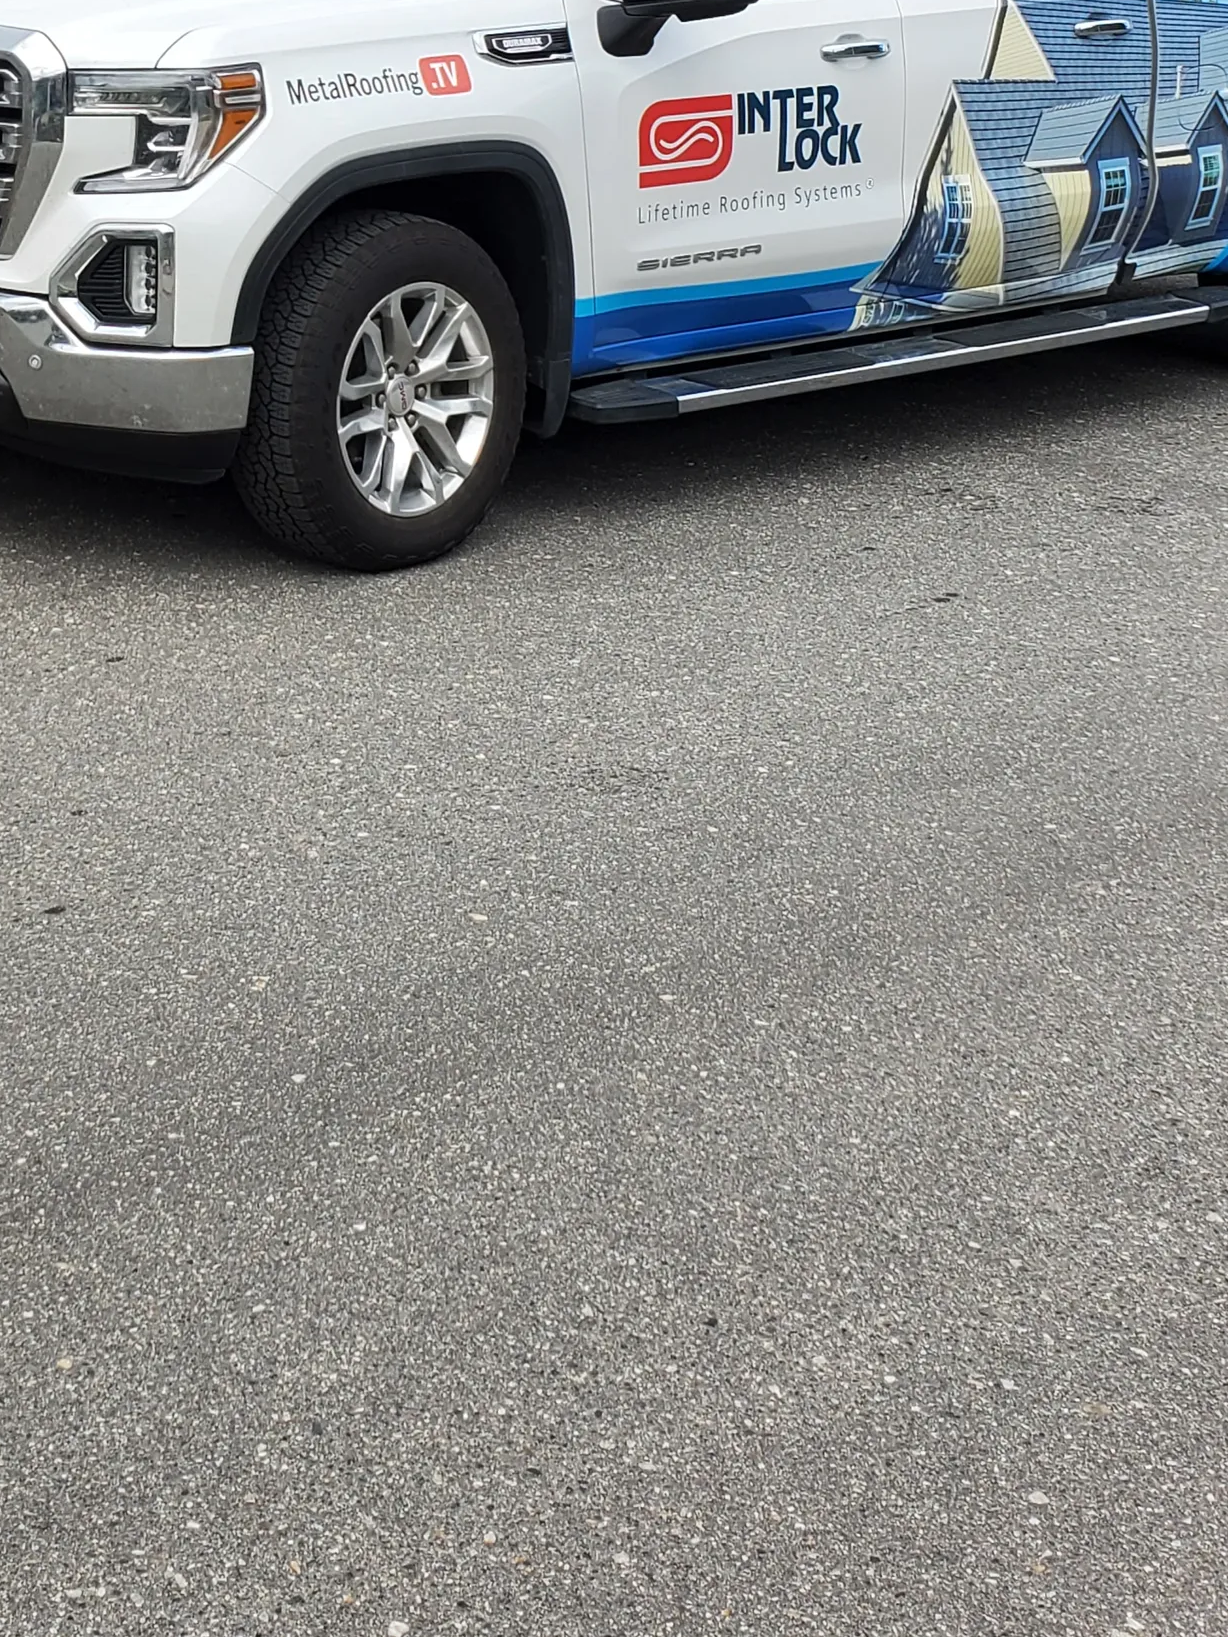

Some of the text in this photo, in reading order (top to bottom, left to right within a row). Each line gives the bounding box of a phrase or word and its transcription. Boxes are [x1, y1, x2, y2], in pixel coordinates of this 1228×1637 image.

[737, 85, 839, 136] INTER
[777, 123, 862, 172] LOCK
[638, 200, 710, 224] Lifetime
[720, 191, 786, 211] Roofing
[637, 244, 762, 271] SIERRA
